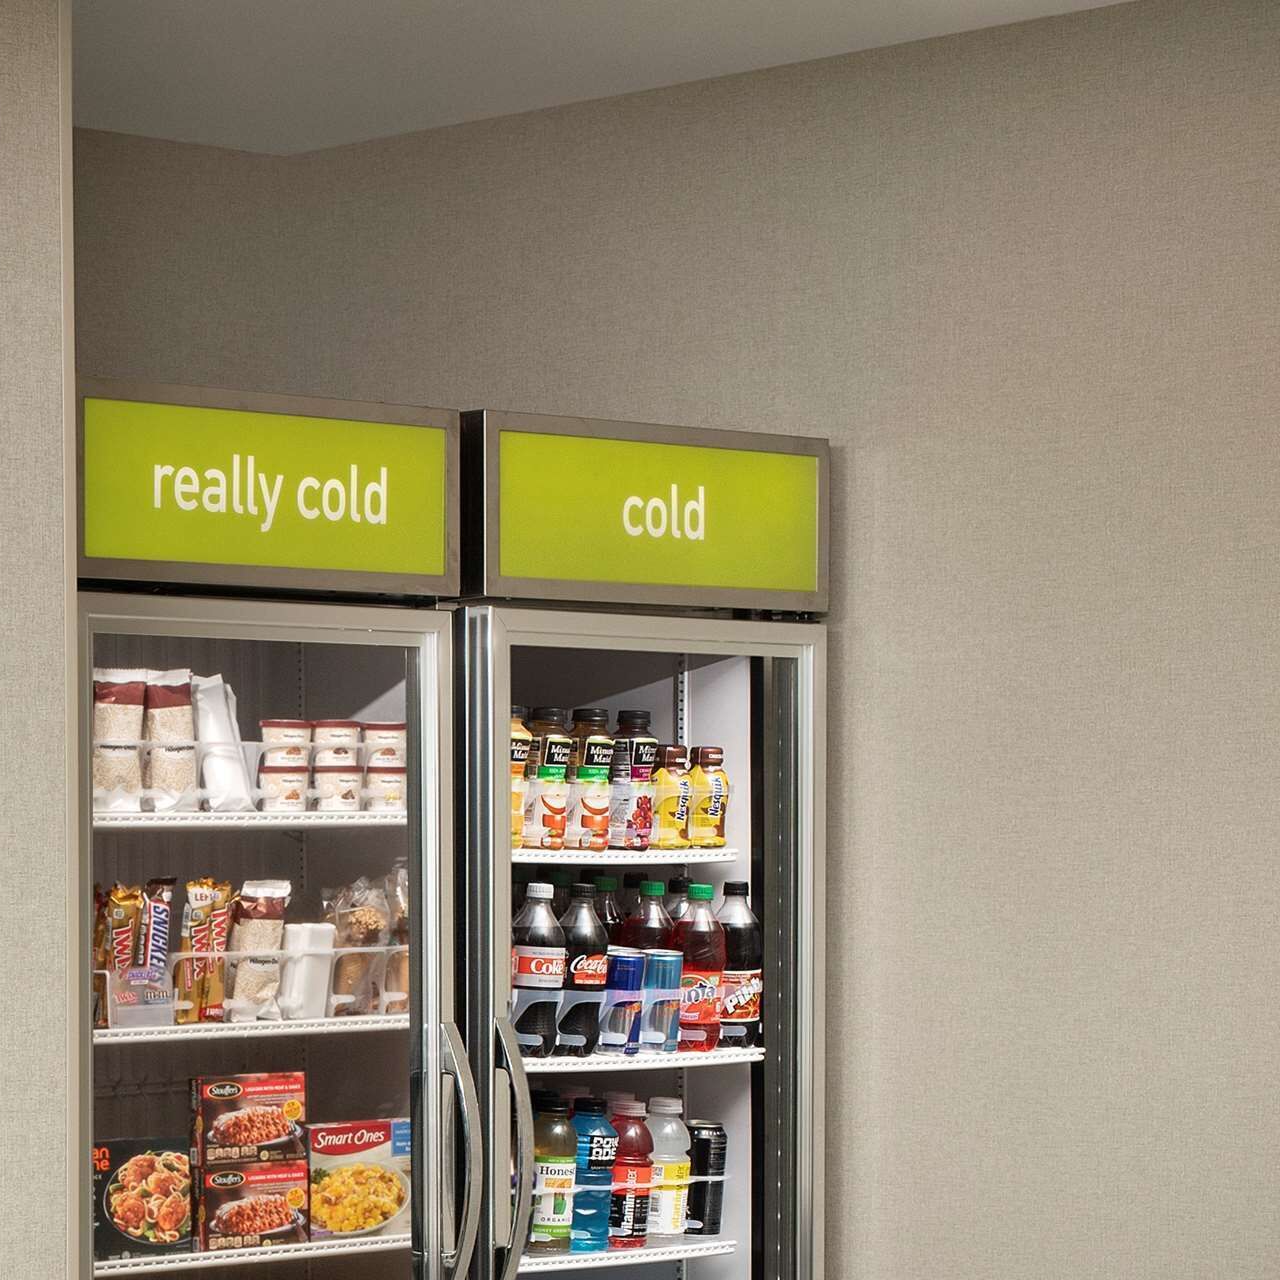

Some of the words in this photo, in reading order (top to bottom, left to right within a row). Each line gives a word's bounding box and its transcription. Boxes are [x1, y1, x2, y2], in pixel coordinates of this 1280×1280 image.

[152, 454, 284, 532] really
[297, 466, 388, 525] cold
[622, 485, 705, 540] cold
[676, 780, 690, 822] Nesquik
[709, 775, 723, 818] Nesquik
[530, 956, 565, 975] Coke
[314, 1131, 352, 1149] Smart
[354, 1129, 385, 1145] Ones
